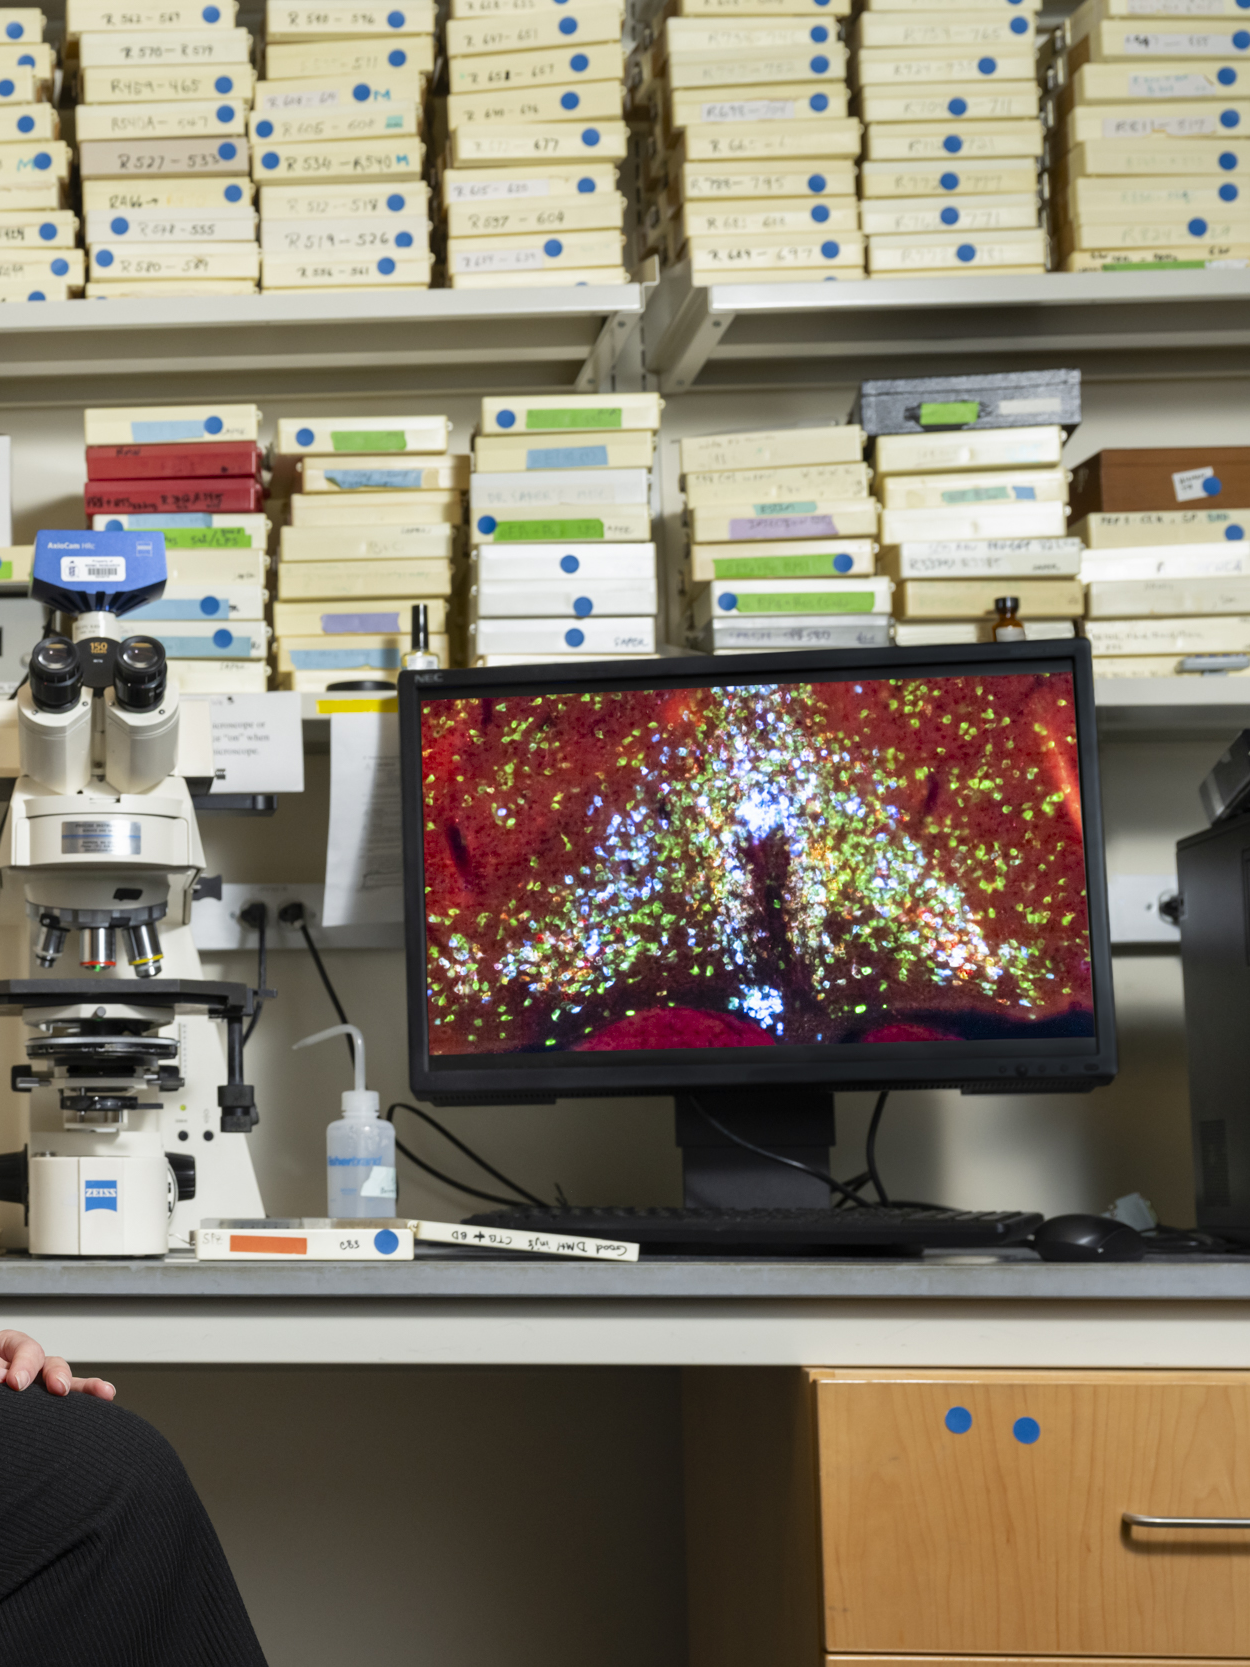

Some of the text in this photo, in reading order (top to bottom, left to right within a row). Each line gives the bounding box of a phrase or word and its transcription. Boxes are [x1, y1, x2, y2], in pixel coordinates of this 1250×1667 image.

[90, 641, 109, 651] 150
[414, 673, 444, 684] NEC
[85, 1187, 118, 1198] ZEISS
